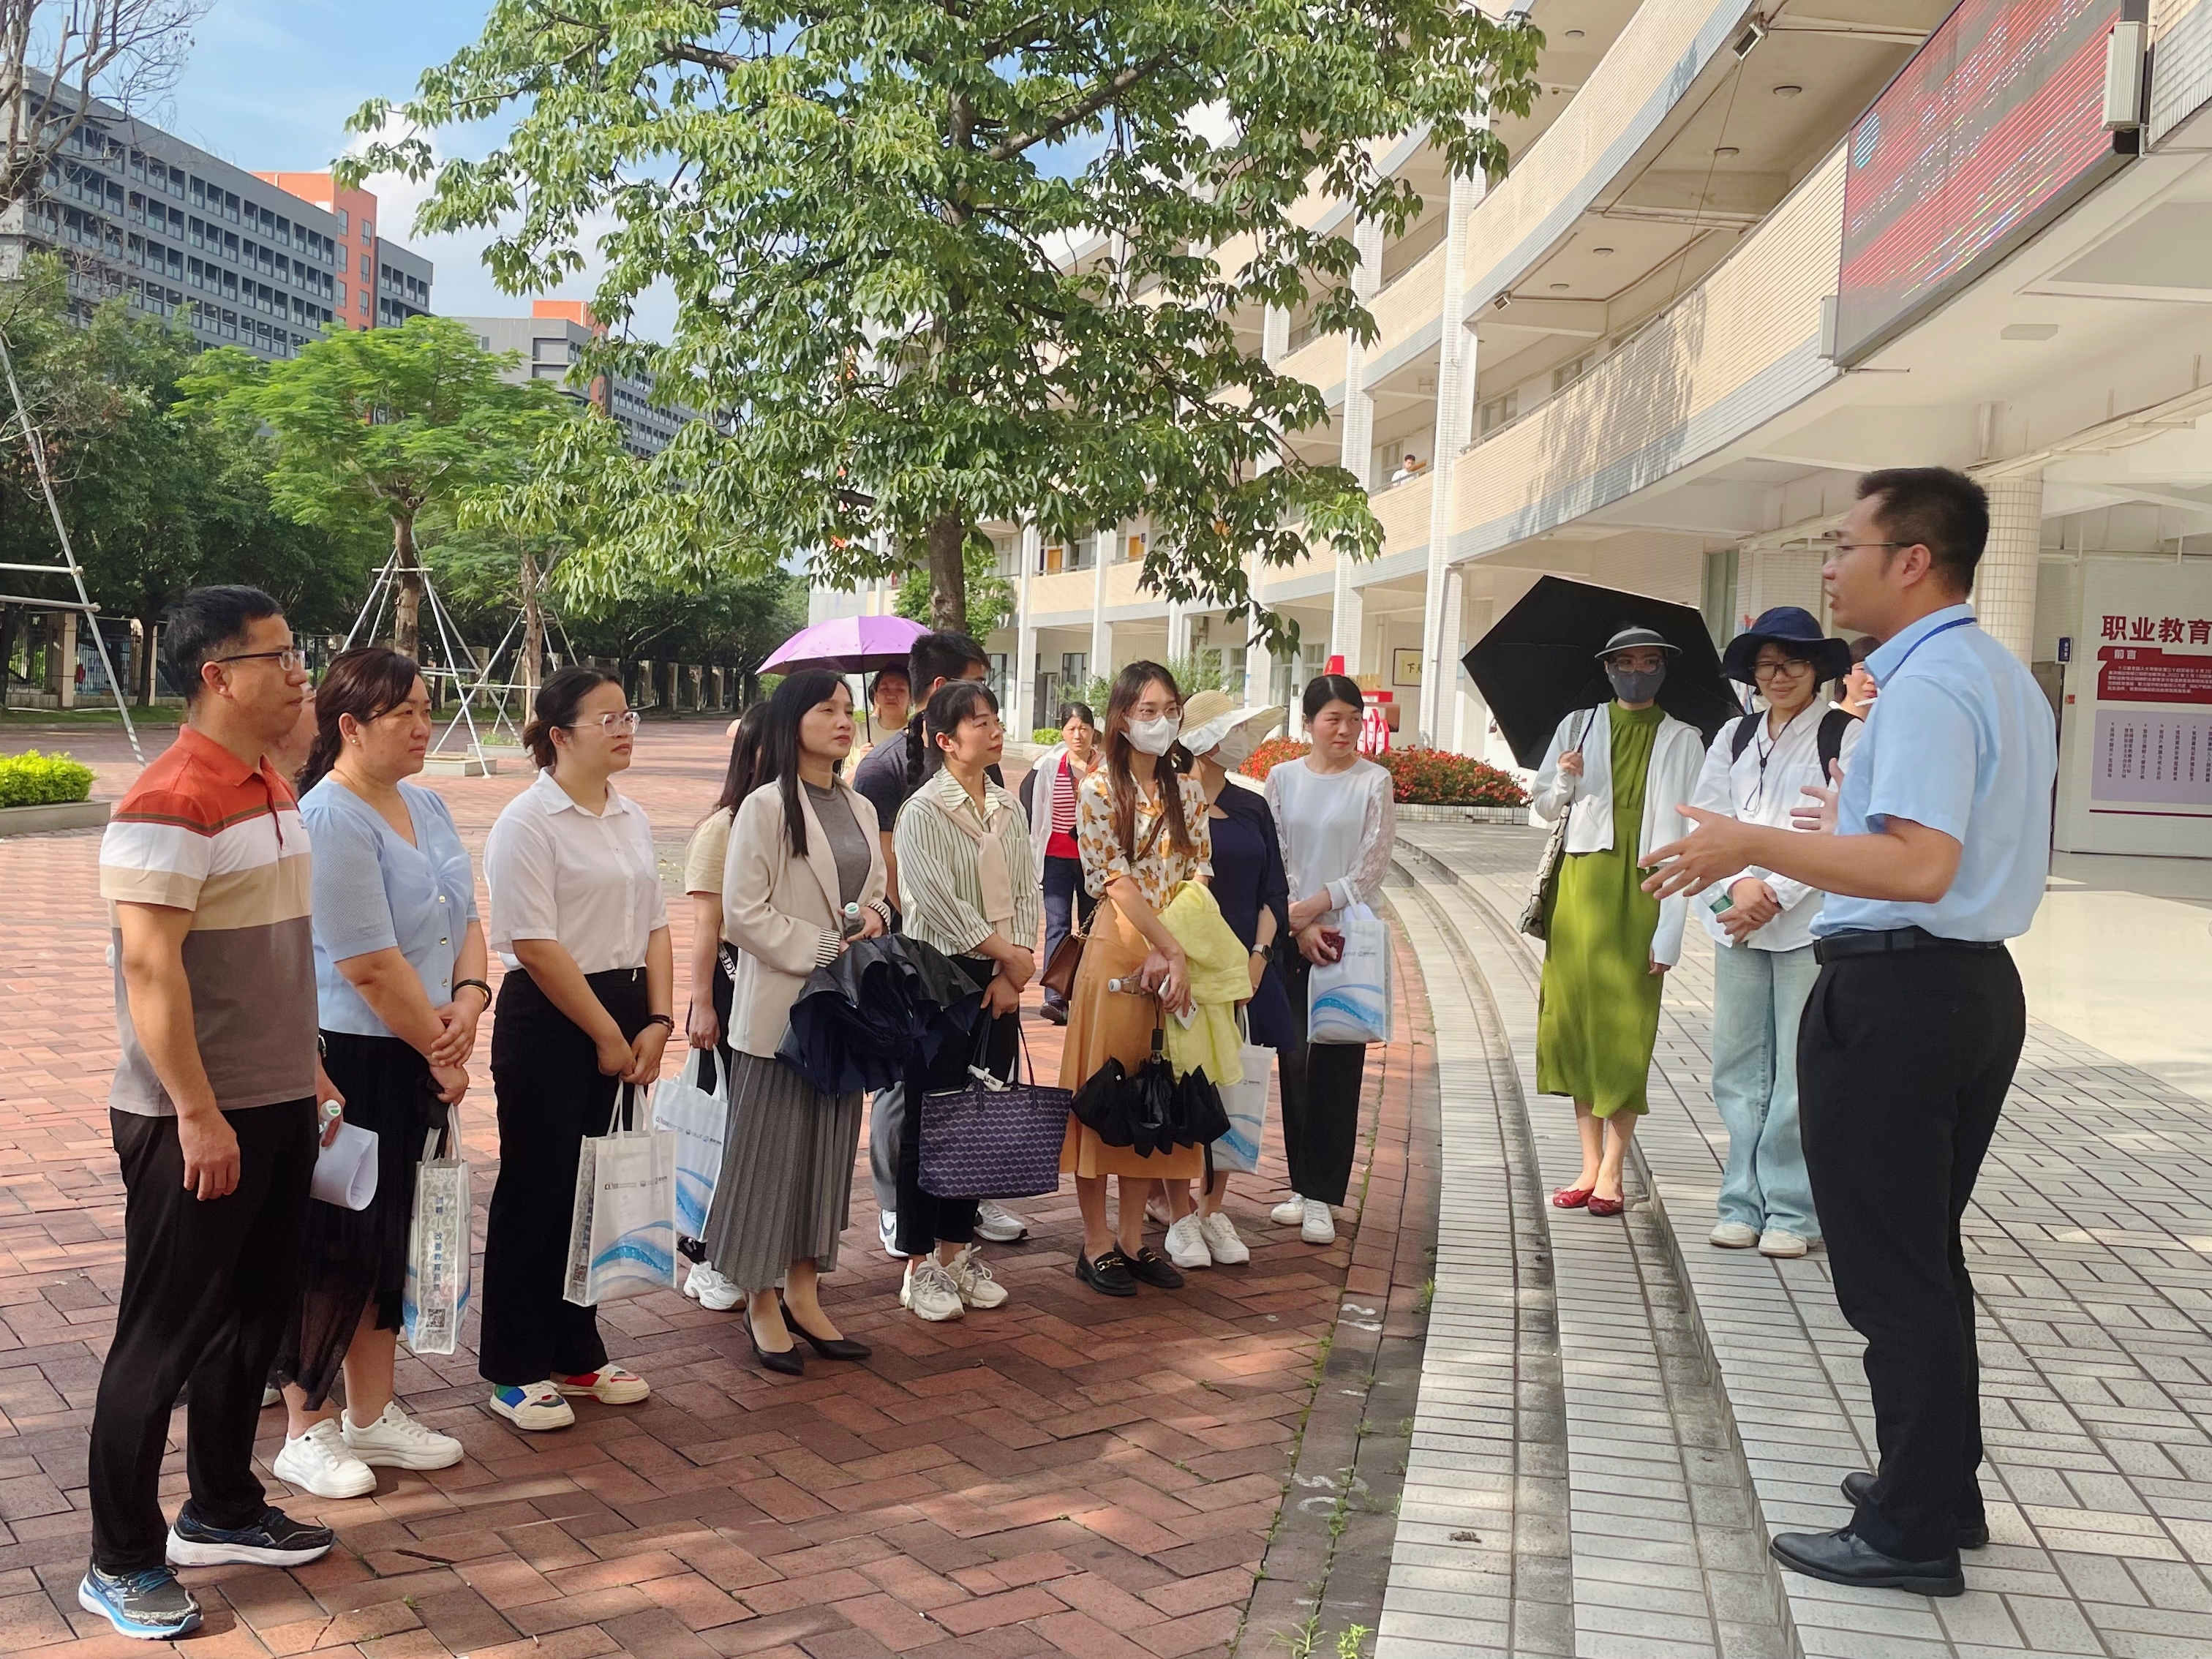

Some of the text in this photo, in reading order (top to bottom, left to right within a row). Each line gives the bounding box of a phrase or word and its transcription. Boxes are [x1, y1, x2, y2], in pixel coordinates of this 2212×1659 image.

[2101, 615, 2212, 644] 职业教育
[721, 953, 736, 981] YCLE
